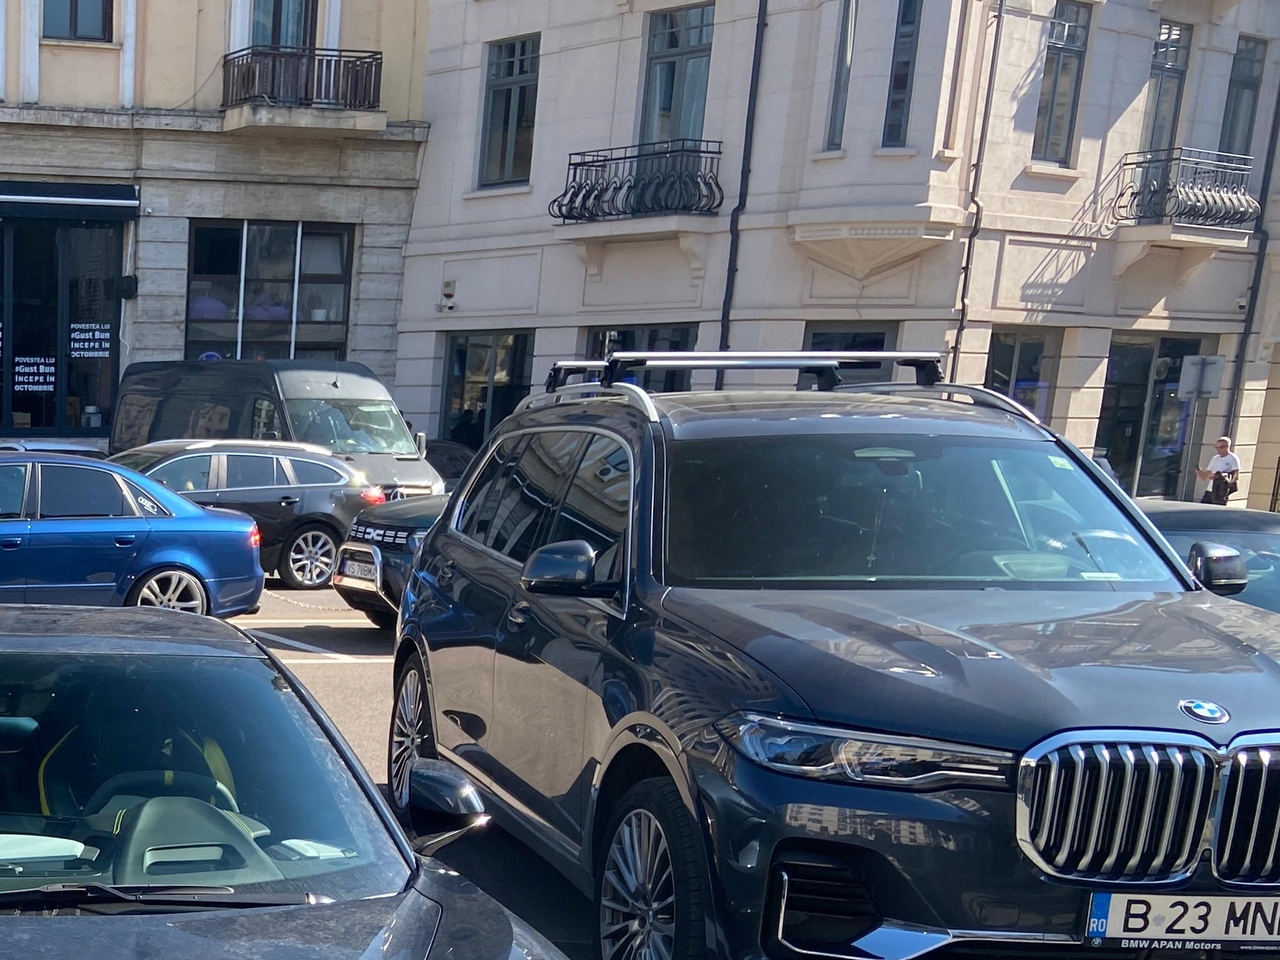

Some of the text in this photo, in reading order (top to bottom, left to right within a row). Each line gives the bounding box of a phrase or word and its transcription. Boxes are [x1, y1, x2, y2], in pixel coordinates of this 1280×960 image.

[1122, 899, 1280, 936] B 23 MN
[1089, 918, 1106, 932] RO
[1121, 940, 1221, 950] BMW APAN Motors
